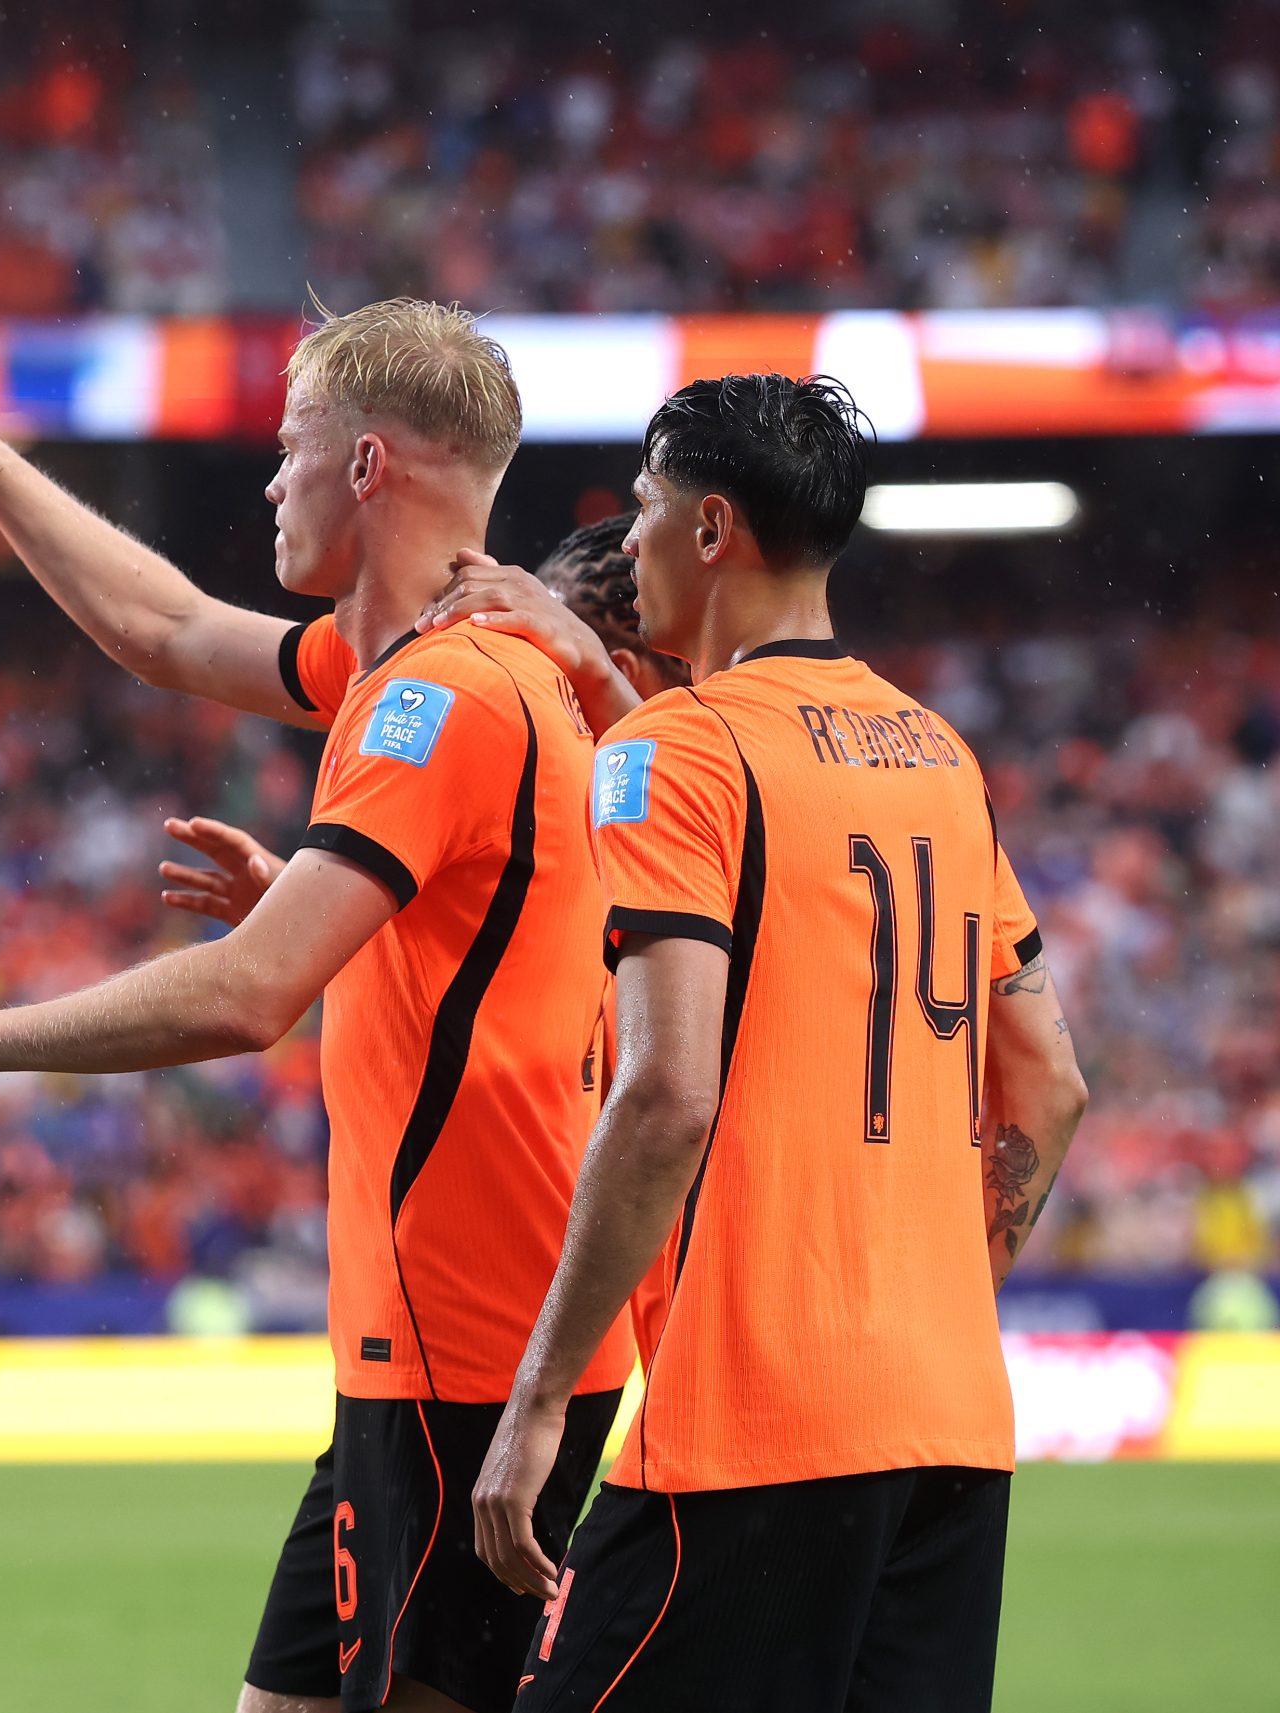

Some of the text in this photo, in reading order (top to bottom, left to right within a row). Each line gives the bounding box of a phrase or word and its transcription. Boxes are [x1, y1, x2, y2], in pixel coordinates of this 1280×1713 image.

[383, 710, 423, 728] Unite For
[380, 724, 417, 744] PEACE
[382, 739, 402, 750] FIFA
[848, 833, 982, 1148] 14
[333, 1500, 359, 1622] 6
